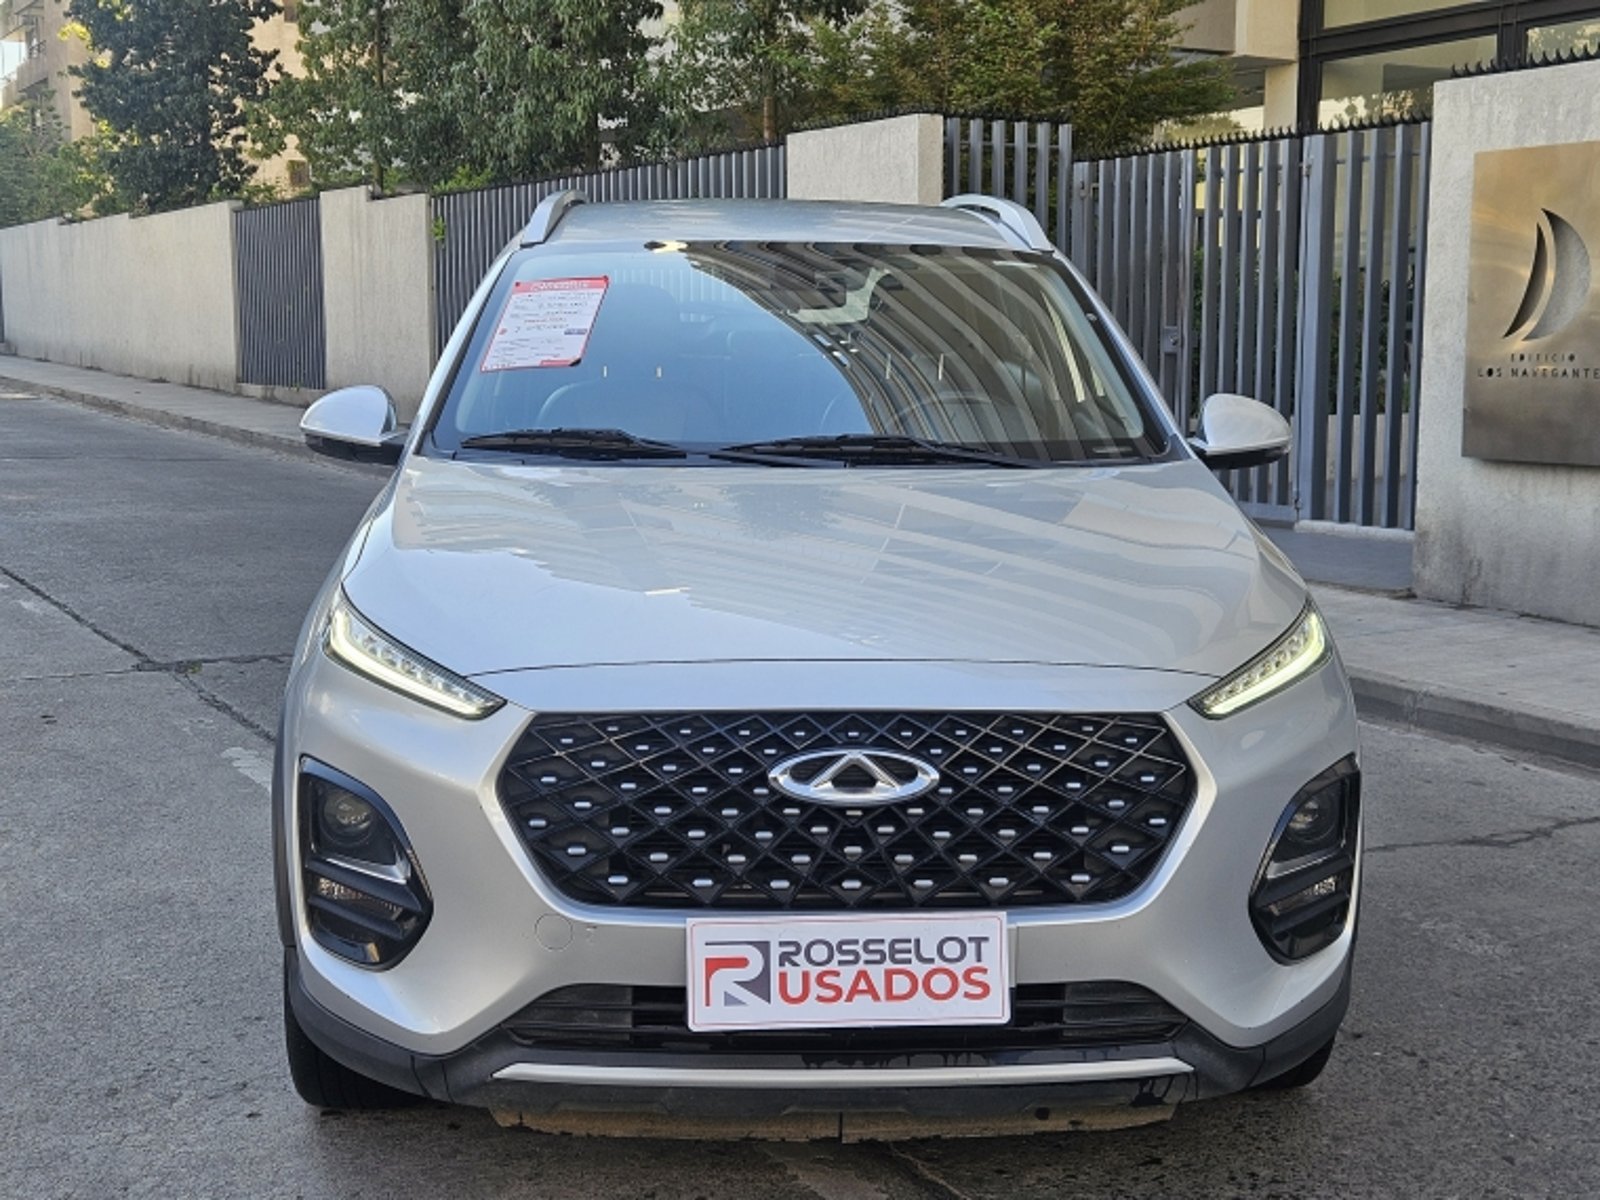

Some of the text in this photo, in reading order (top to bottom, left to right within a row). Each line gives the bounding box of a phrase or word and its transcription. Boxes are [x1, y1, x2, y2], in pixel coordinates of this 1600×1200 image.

[1478, 368, 1502, 378] LOS
[778, 936, 990, 967] ROSSELOT
[778, 966, 991, 1004] USADOS
